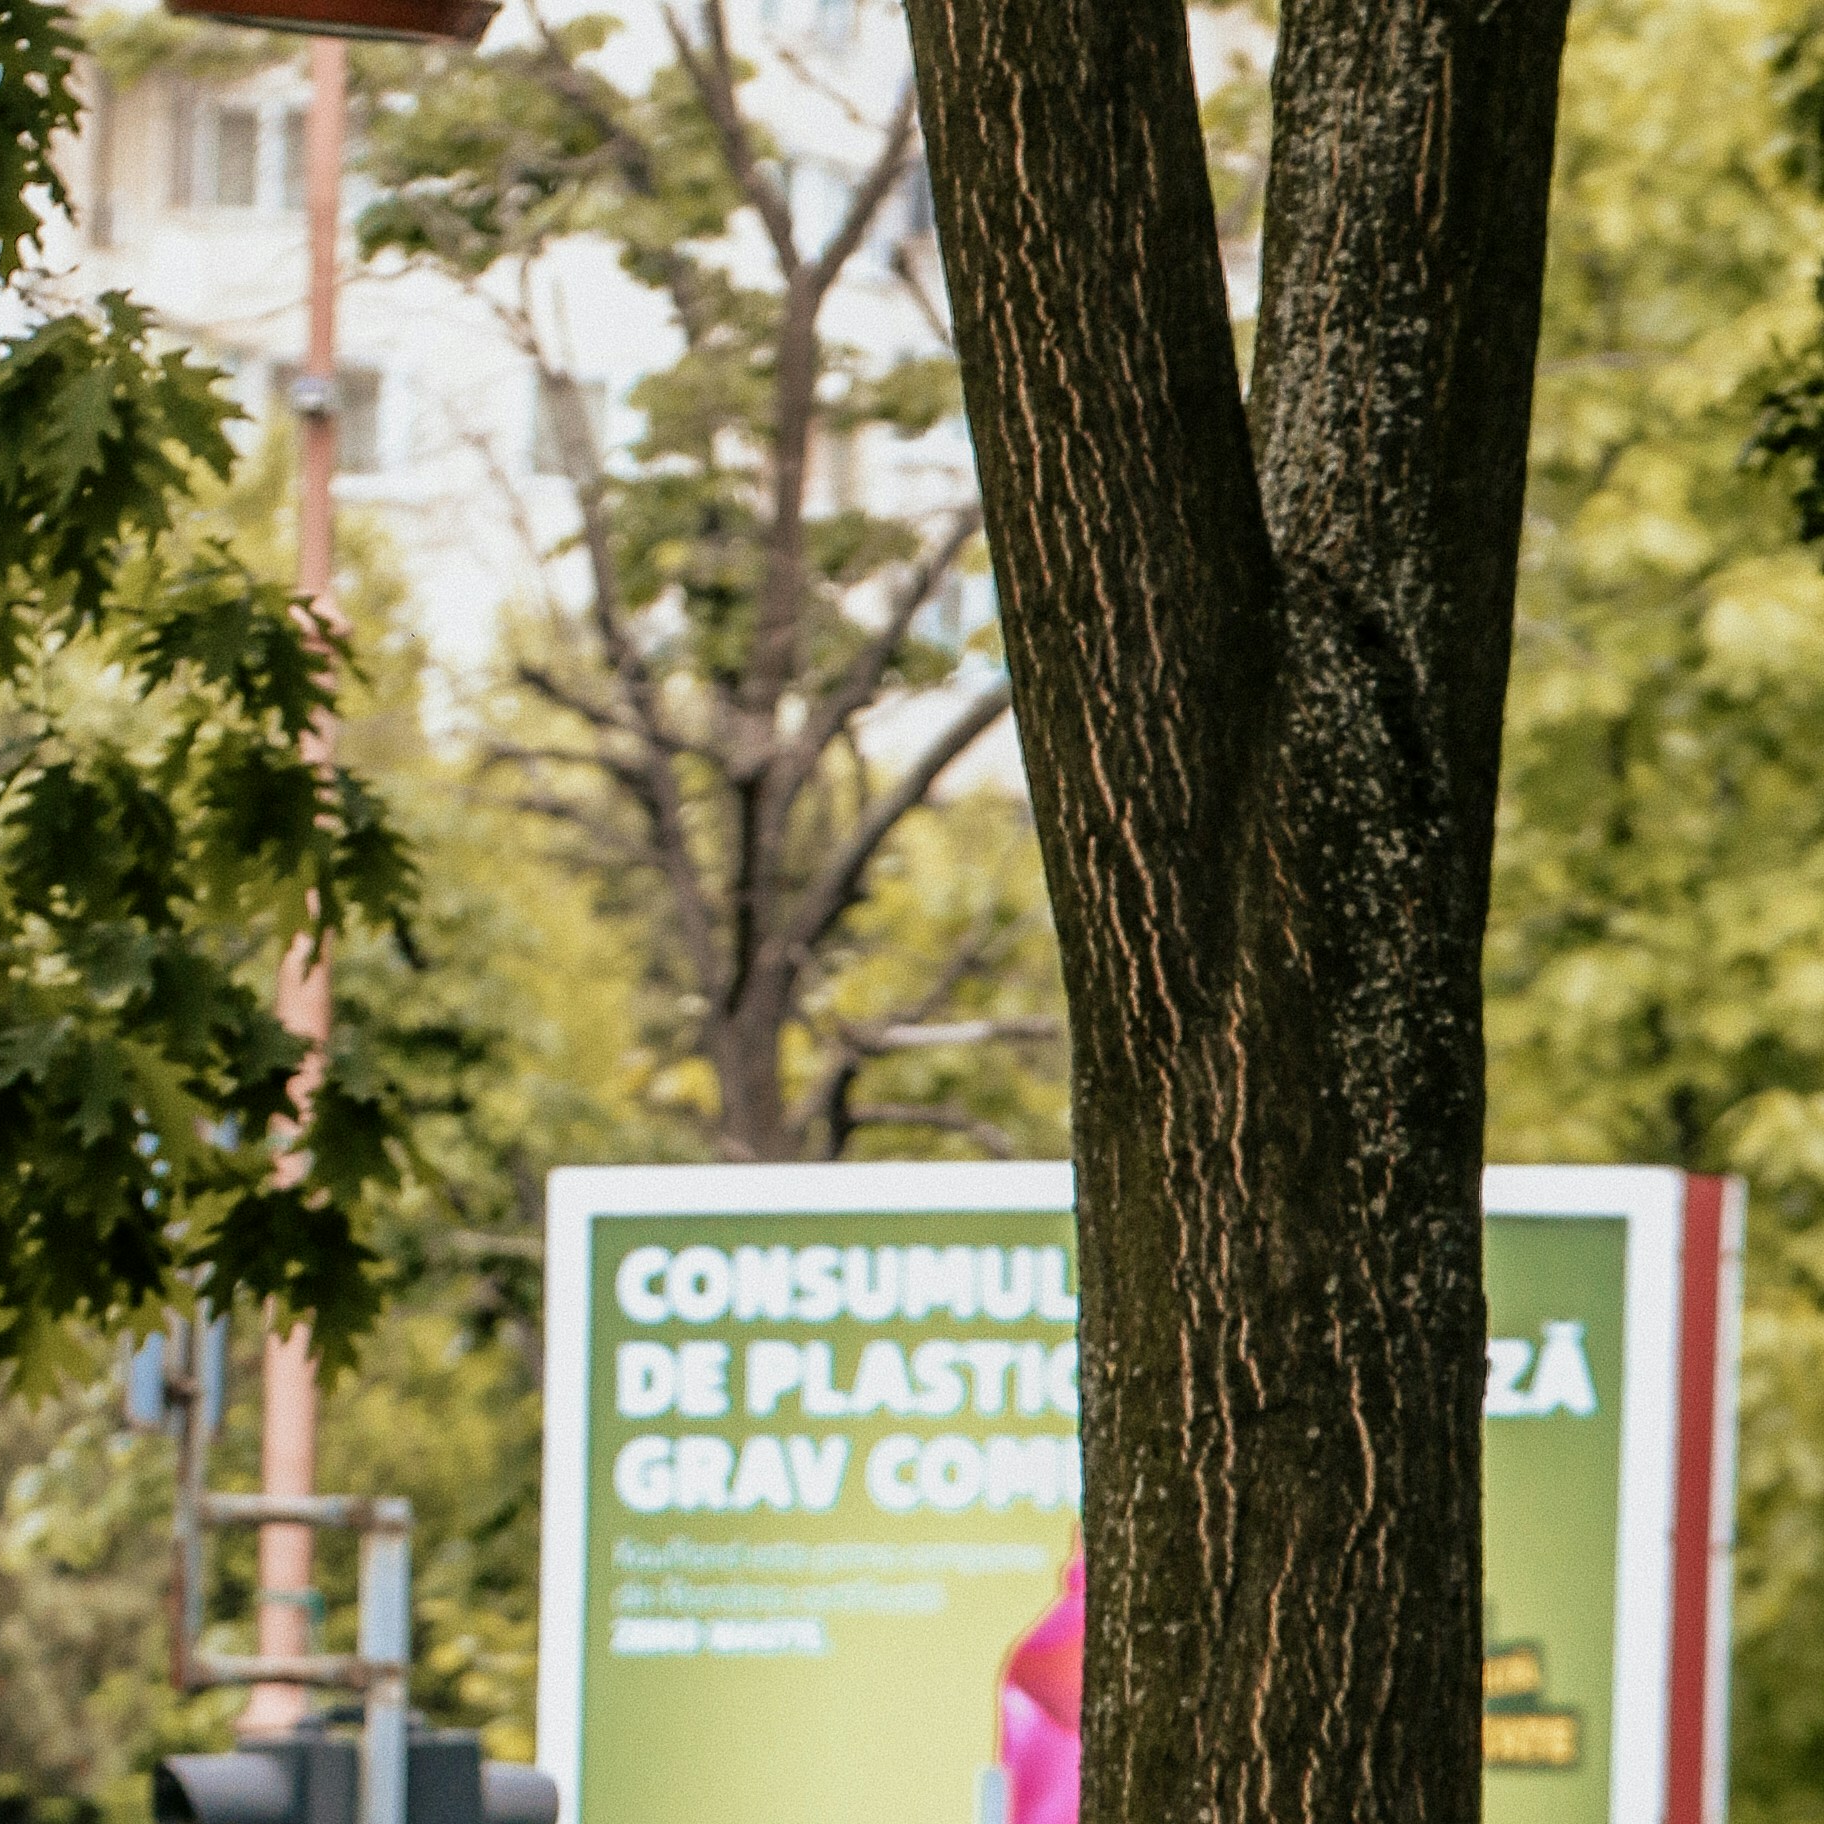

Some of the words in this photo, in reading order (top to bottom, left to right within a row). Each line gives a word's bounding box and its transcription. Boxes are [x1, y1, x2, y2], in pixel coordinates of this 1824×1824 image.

[616, 1245, 1079, 1322] CONSUMUL
[616, 1339, 731, 1418] DE
[614, 1433, 851, 1515] GRAV
[865, 1433, 1082, 1513] COM
